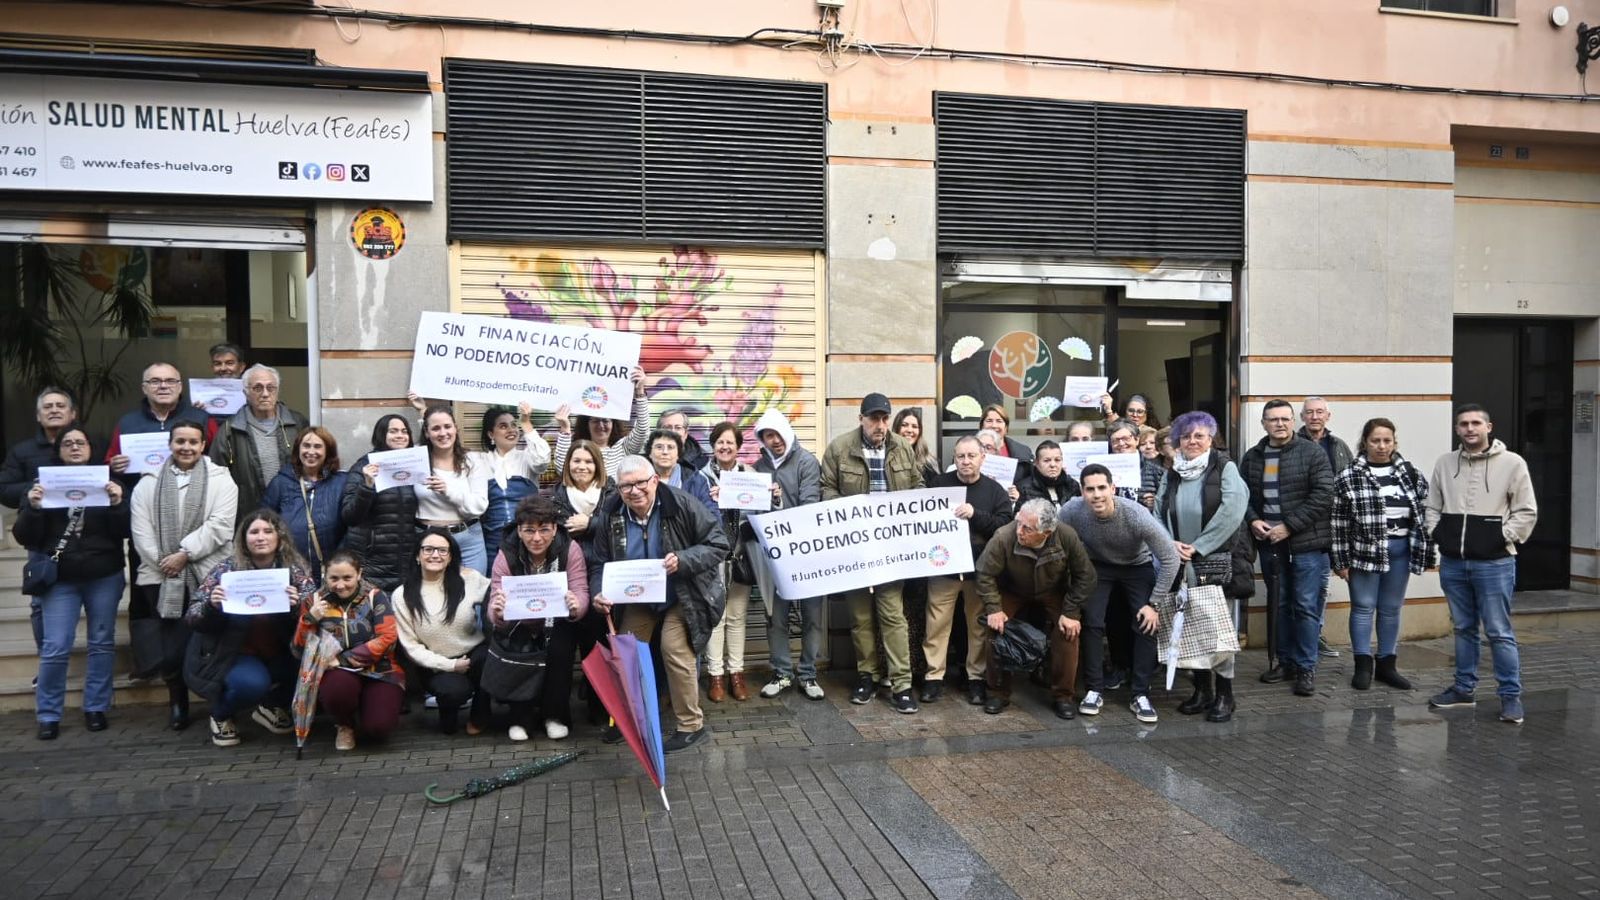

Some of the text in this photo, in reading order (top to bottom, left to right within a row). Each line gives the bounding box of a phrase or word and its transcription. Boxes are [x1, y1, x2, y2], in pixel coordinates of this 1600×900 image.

[48, 100, 125, 128] SALUD
[135, 104, 230, 133] MENTAL
[14, 146, 37, 156] 410
[12, 167, 37, 177] 467
[82, 158, 233, 175] www.feafes-huelva.org
[441, 322, 465, 337] SIN
[426, 343, 629, 380] NO PODEMOS CONTINUAR
[789, 529, 870, 555] PODEMOS
[874, 519, 959, 541] CONTINUAR
